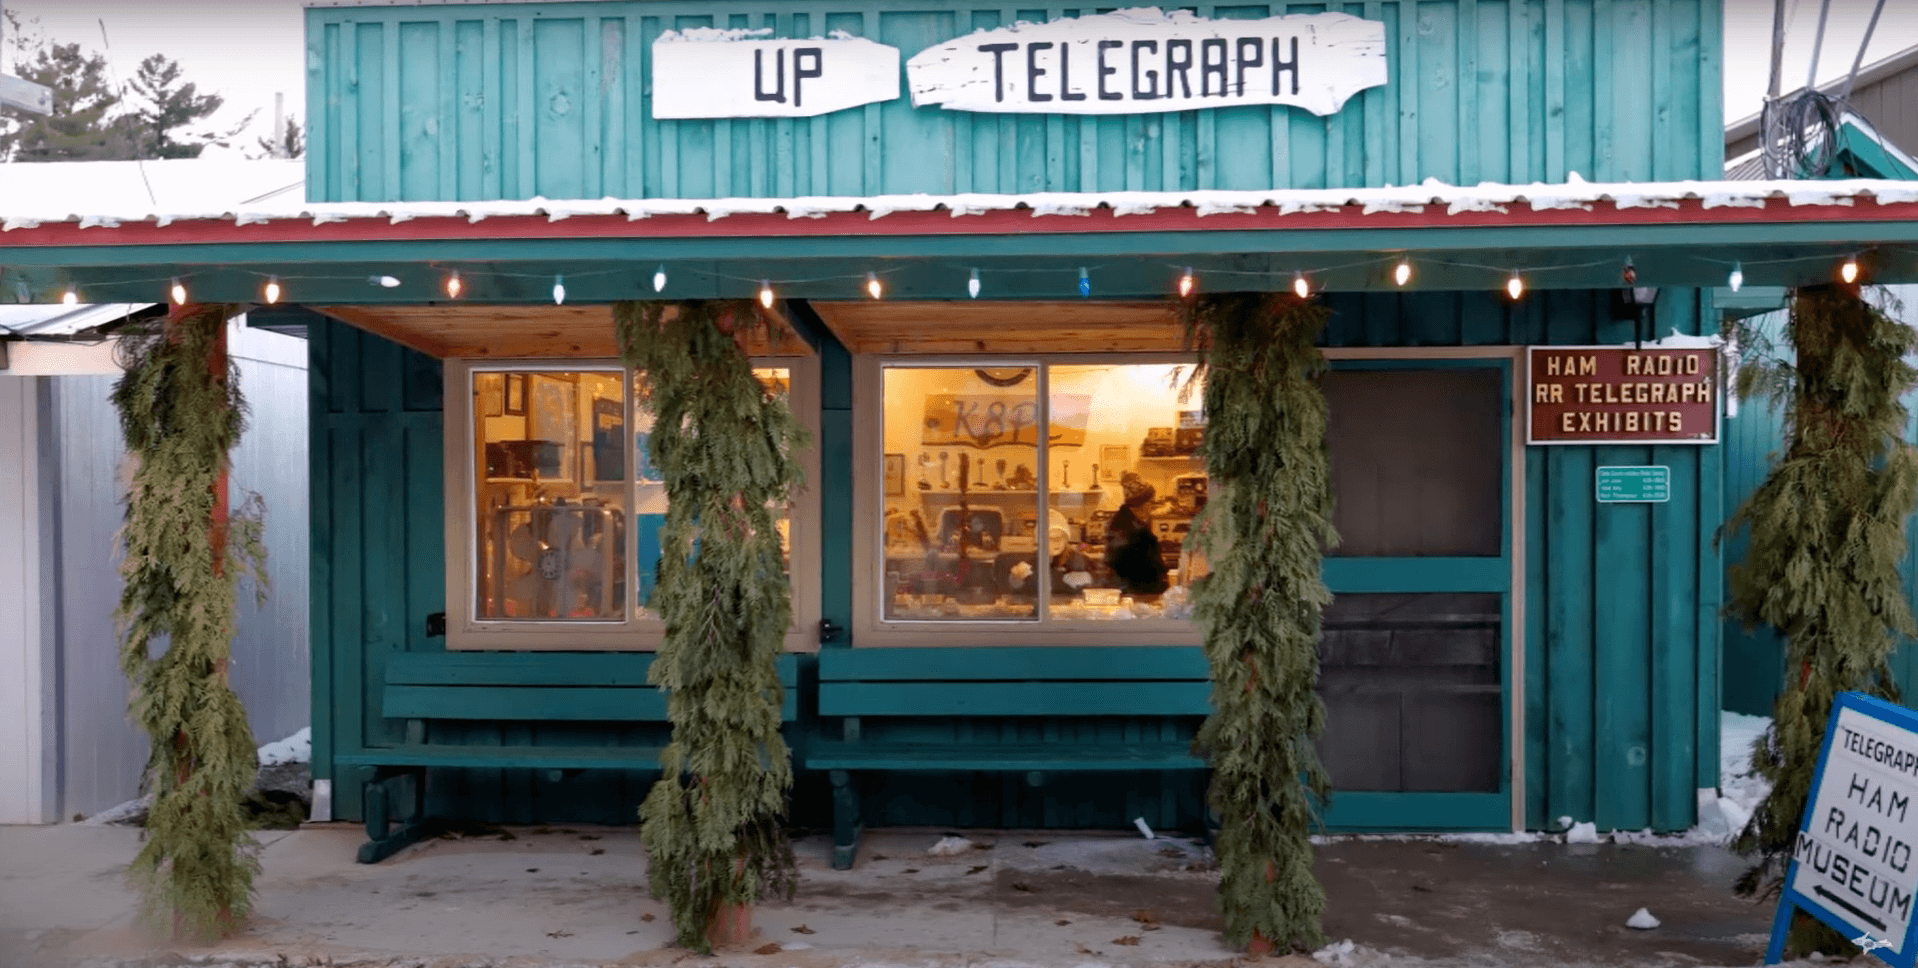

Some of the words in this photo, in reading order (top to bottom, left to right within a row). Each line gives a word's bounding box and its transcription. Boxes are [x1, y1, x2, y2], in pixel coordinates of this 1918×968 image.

[754, 48, 823, 107] UP
[978, 37, 1300, 101] TELEGRAPH
[1547, 356, 1597, 376] HAM
[1627, 355, 1700, 375] RADIO
[1536, 383, 1564, 403] RR
[1575, 383, 1711, 403] TELEGRAPH
[1562, 411, 1682, 432] EXHIBITS
[1847, 773, 1909, 823] HAM
[1825, 807, 1911, 873] RADIO
[1796, 834, 1911, 921] MUSEUM
